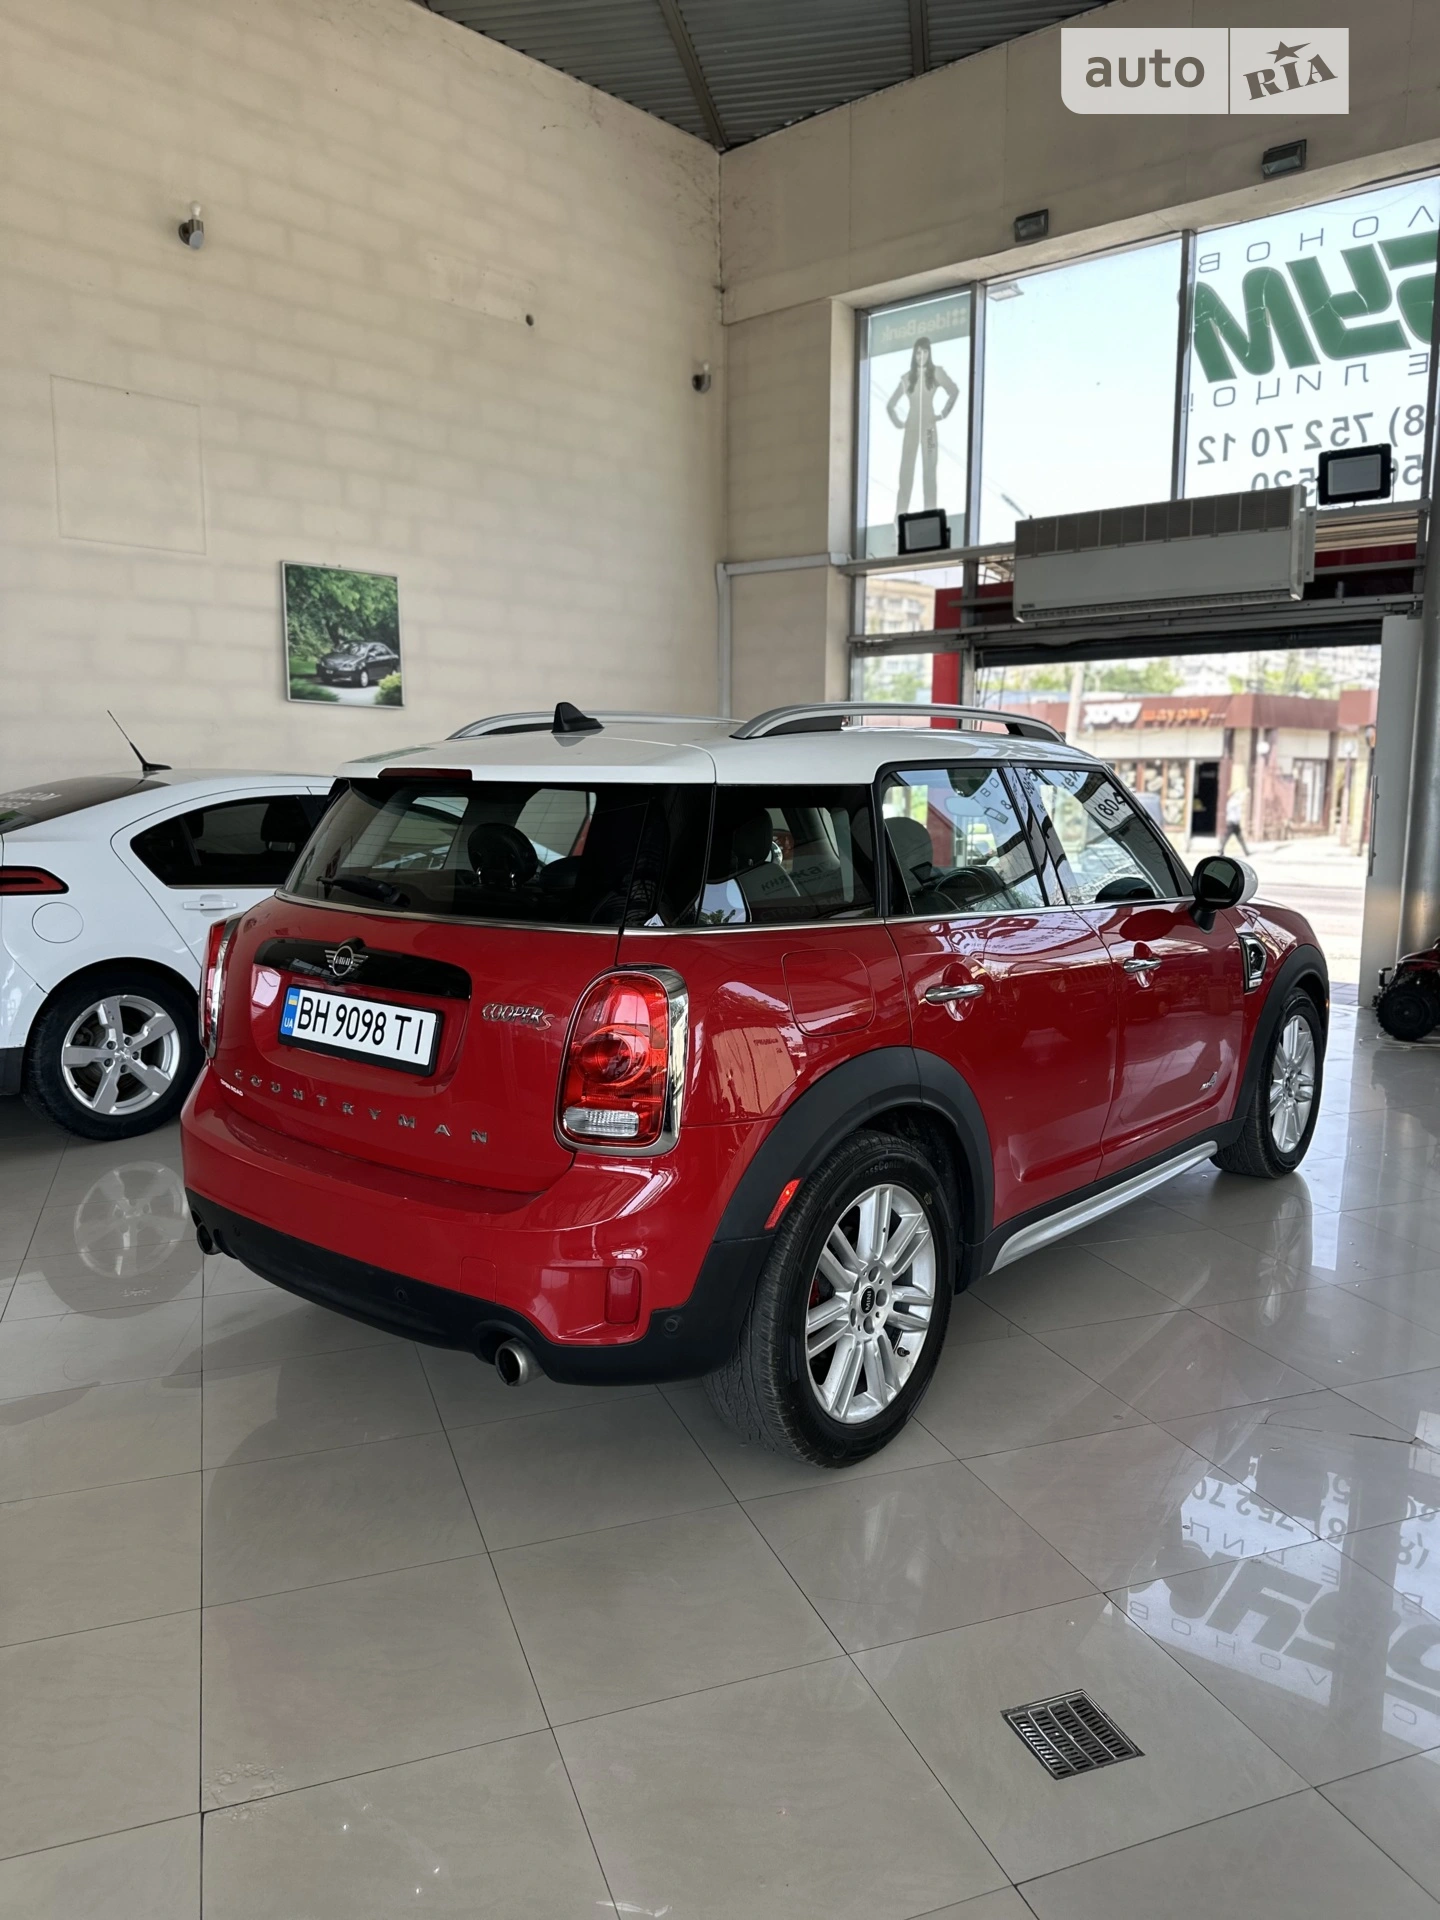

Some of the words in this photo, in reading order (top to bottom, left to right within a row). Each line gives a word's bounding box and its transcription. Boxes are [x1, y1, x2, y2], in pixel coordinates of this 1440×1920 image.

[283, 1016, 294, 1030] UA
[297, 996, 329, 1035] BH
[332, 1002, 388, 1046] 9098
[394, 1014, 423, 1055] TI
[482, 1003, 543, 1024] COOPER
[234, 1069, 488, 1144] COUNTRYMAN
